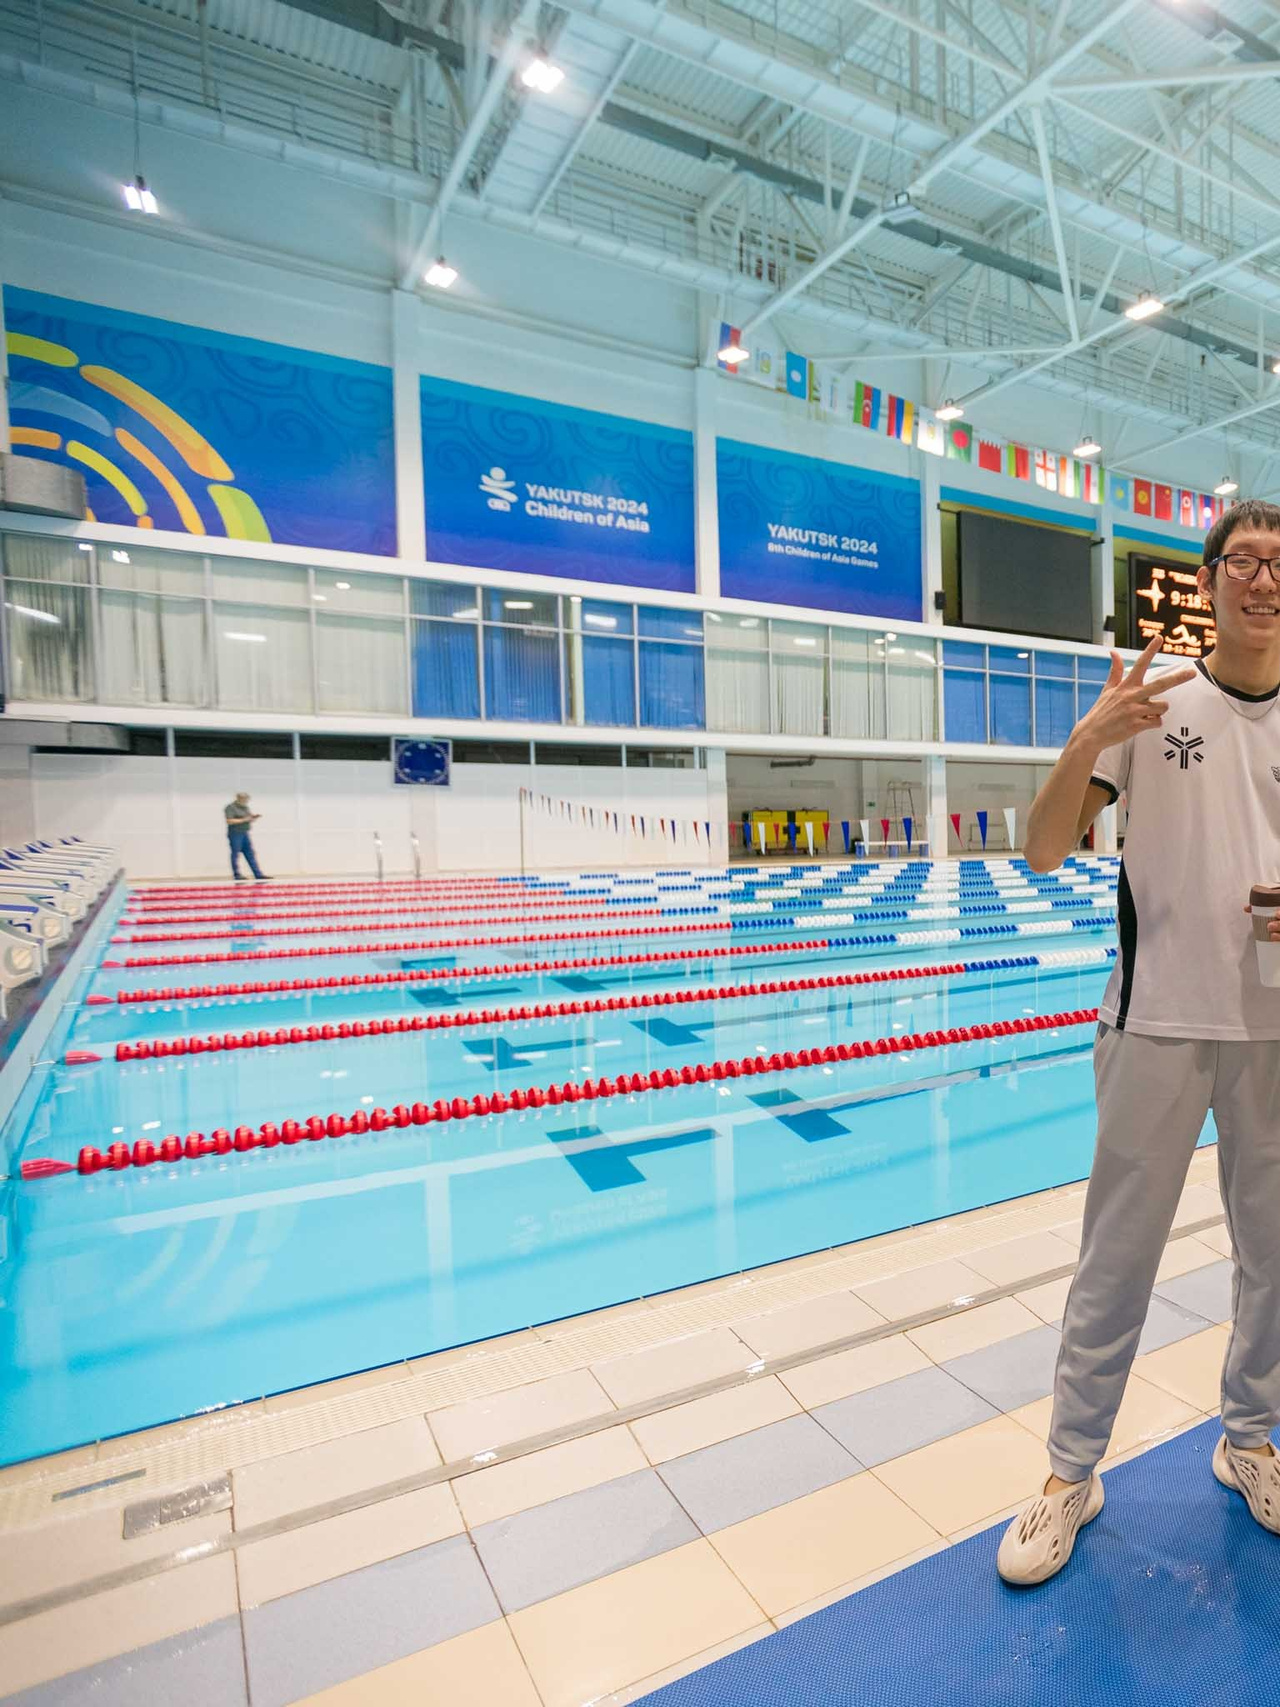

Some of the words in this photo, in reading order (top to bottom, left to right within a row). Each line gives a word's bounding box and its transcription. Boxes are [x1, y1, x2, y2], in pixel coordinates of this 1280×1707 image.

[525, 482, 604, 509] YAKUTSK
[607, 497, 649, 516] 2024
[525, 500, 594, 525] Children
[597, 515, 614, 527] of
[616, 515, 650, 533] Asia
[767, 522, 838, 548] YAKUTSK
[841, 536, 878, 555] 2024
[785, 544, 821, 559] Children
[821, 551, 831, 560] of
[832, 553, 850, 565] Asia
[851, 556, 879, 569] Games
[1170, 590, 1212, 612] 9:18:
